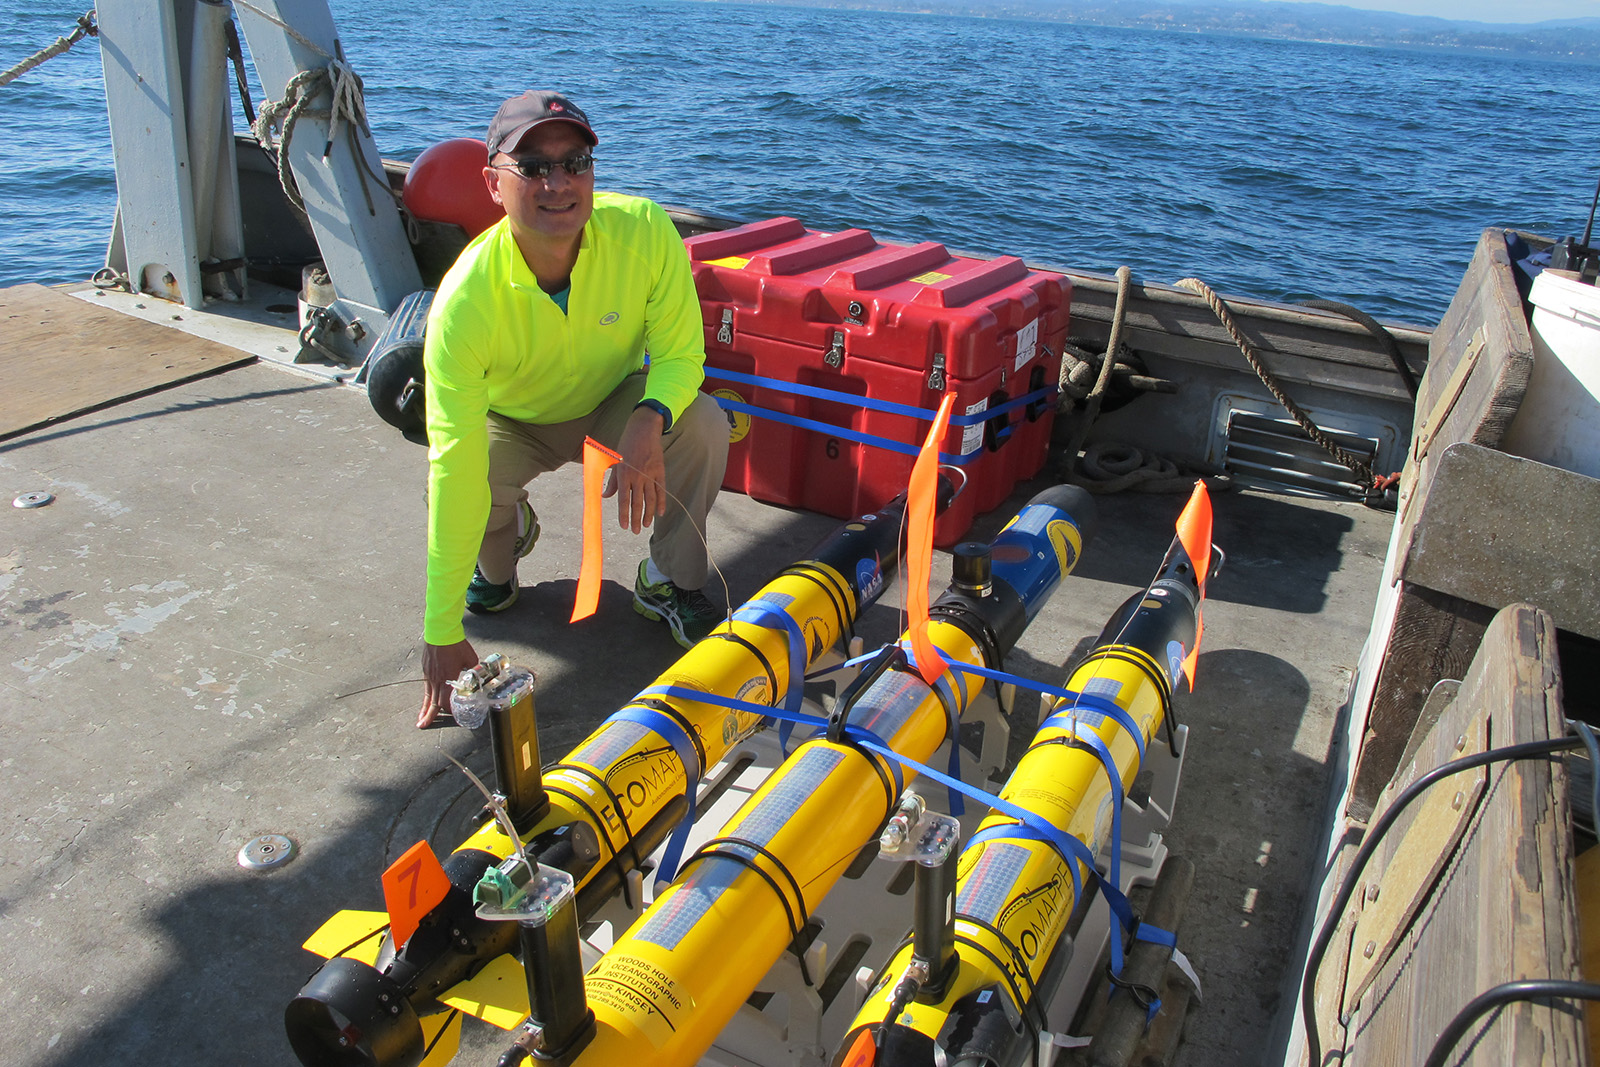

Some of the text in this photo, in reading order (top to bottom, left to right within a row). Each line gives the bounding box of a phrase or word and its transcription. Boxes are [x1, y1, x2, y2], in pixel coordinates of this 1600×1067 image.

[826, 438, 840, 460] 6
[861, 573, 883, 601] NASA
[397, 858, 422, 910] 7
[604, 970, 660, 1000] INSTITUTION
[611, 963, 682, 1010] OCEANOGRAPHIC
[618, 956, 676, 989] WOODS HOLE
[585, 981, 656, 1016] AMES KINSEY
